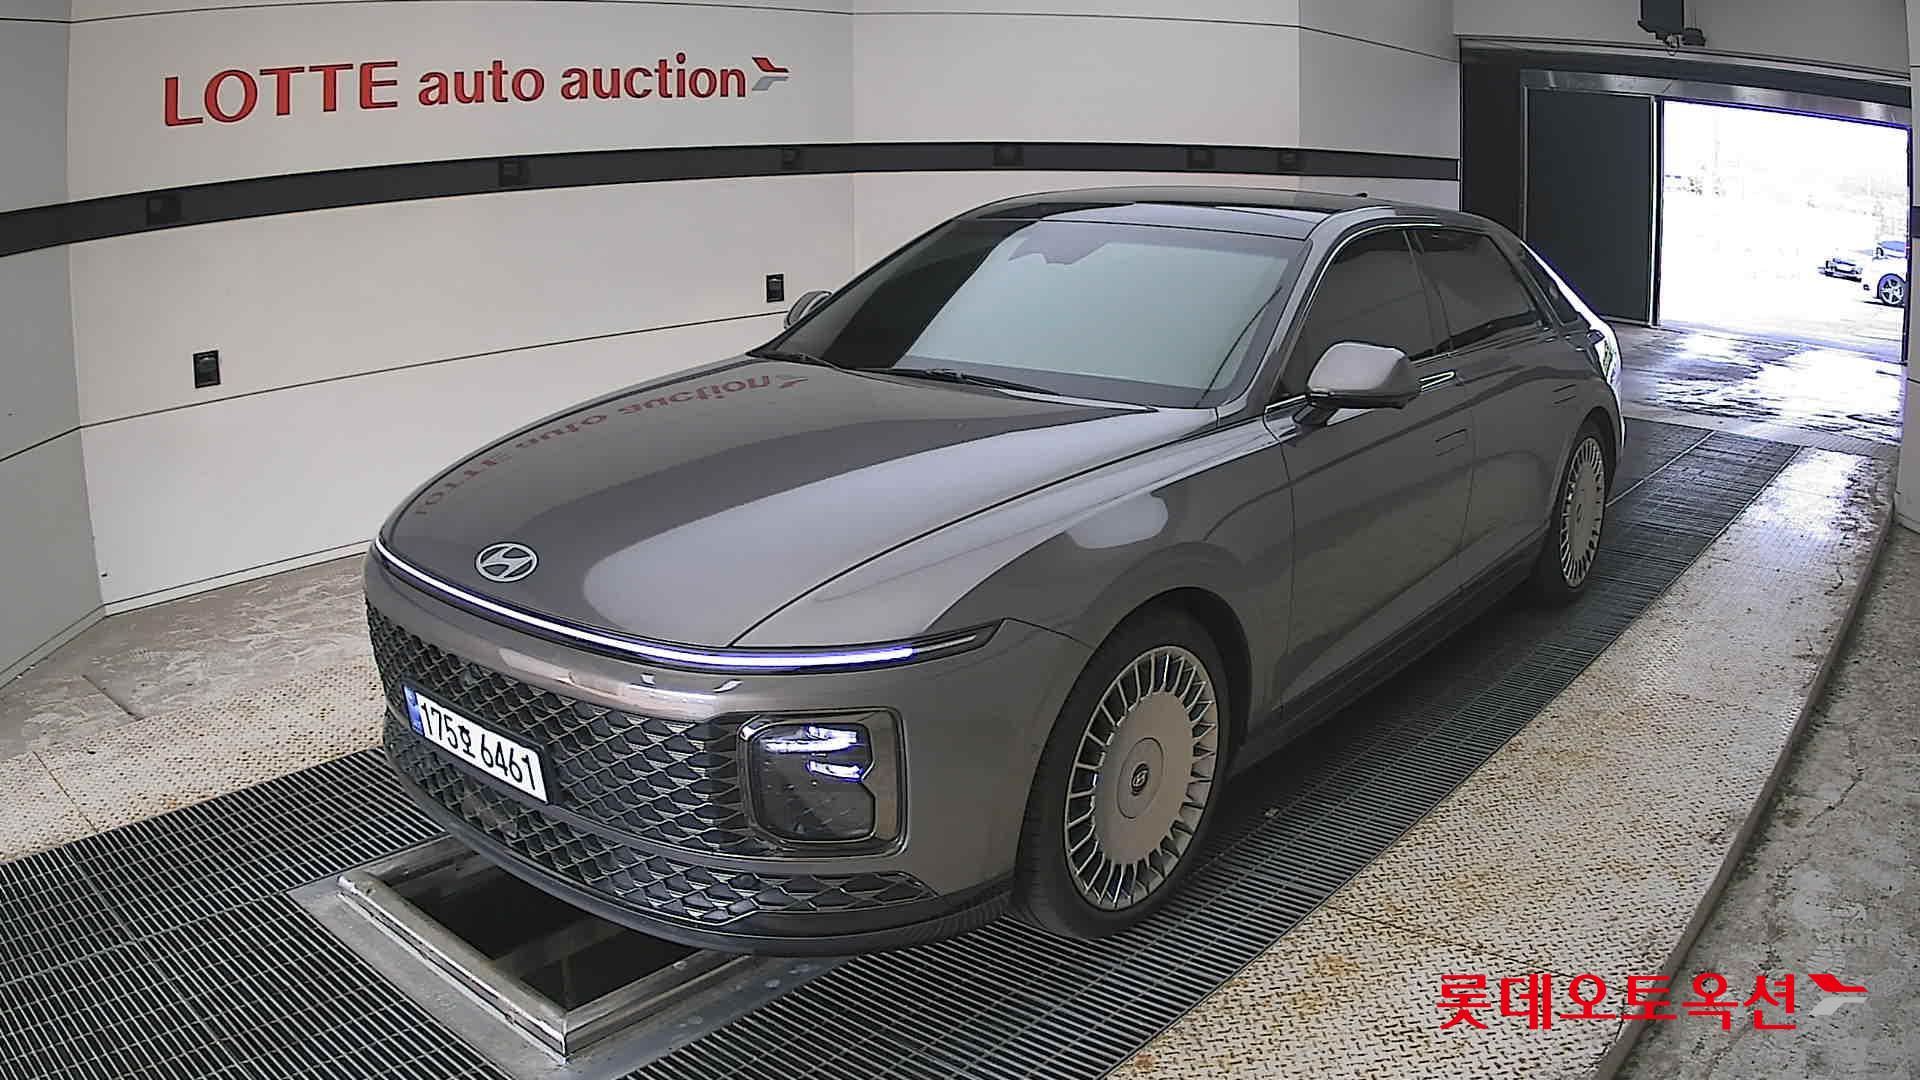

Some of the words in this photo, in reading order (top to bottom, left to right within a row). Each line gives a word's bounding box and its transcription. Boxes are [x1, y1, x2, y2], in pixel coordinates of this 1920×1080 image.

[162, 60, 399, 128] LOTTE
[418, 59, 545, 107] auto
[560, 52, 747, 100] auction
[480, 733, 536, 791] 6461
